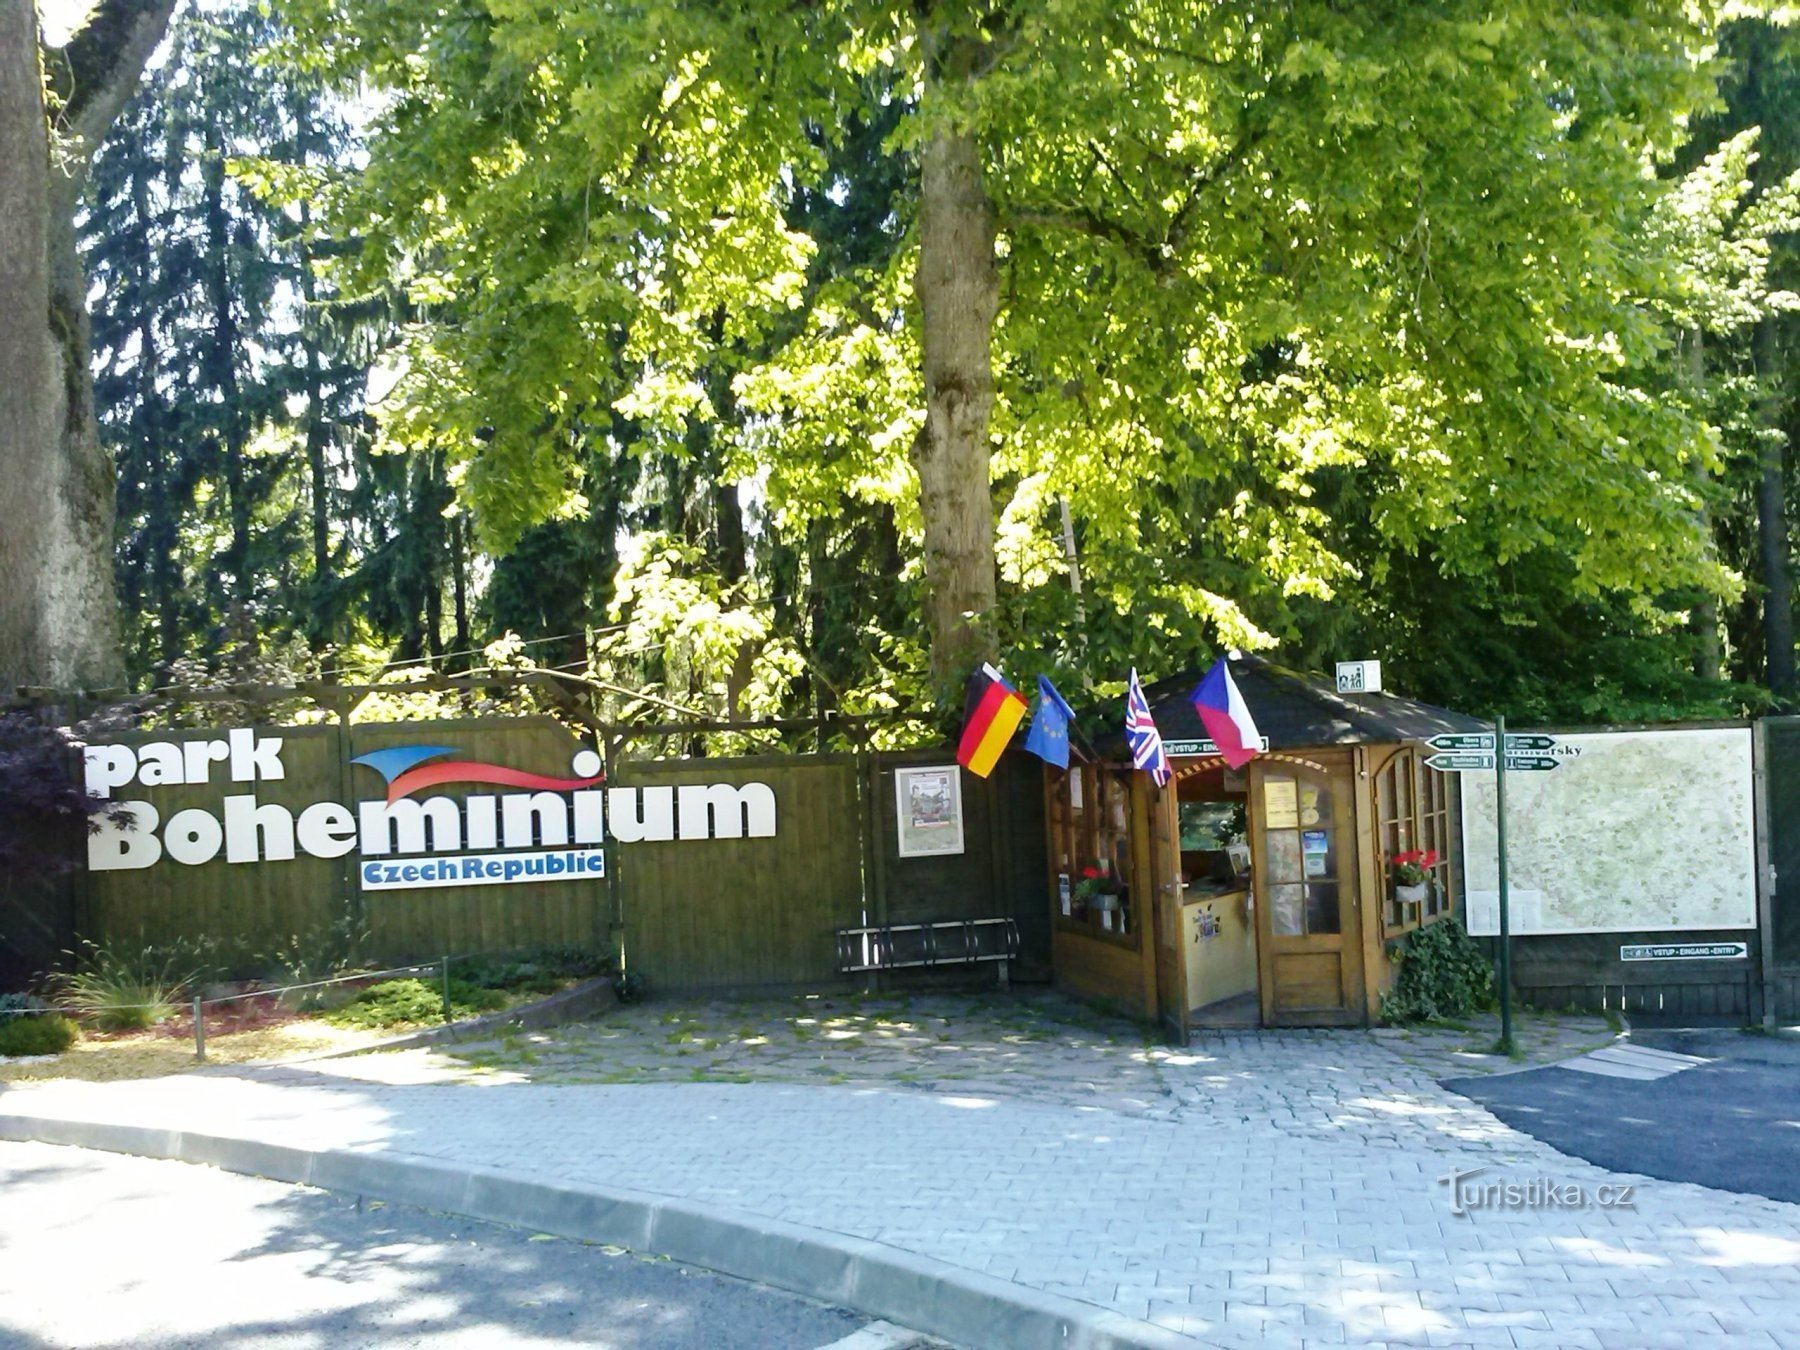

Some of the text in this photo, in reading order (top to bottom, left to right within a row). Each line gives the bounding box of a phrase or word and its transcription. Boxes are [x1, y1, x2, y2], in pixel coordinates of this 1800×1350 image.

[84, 728, 285, 799] park
[1174, 743, 1198, 753] VSTUP
[87, 750, 776, 872] Boheminium
[363, 853, 602, 884] Czech Republic
[1680, 948, 1709, 956] EINGANG
[1713, 947, 1736, 955] ENTRY
